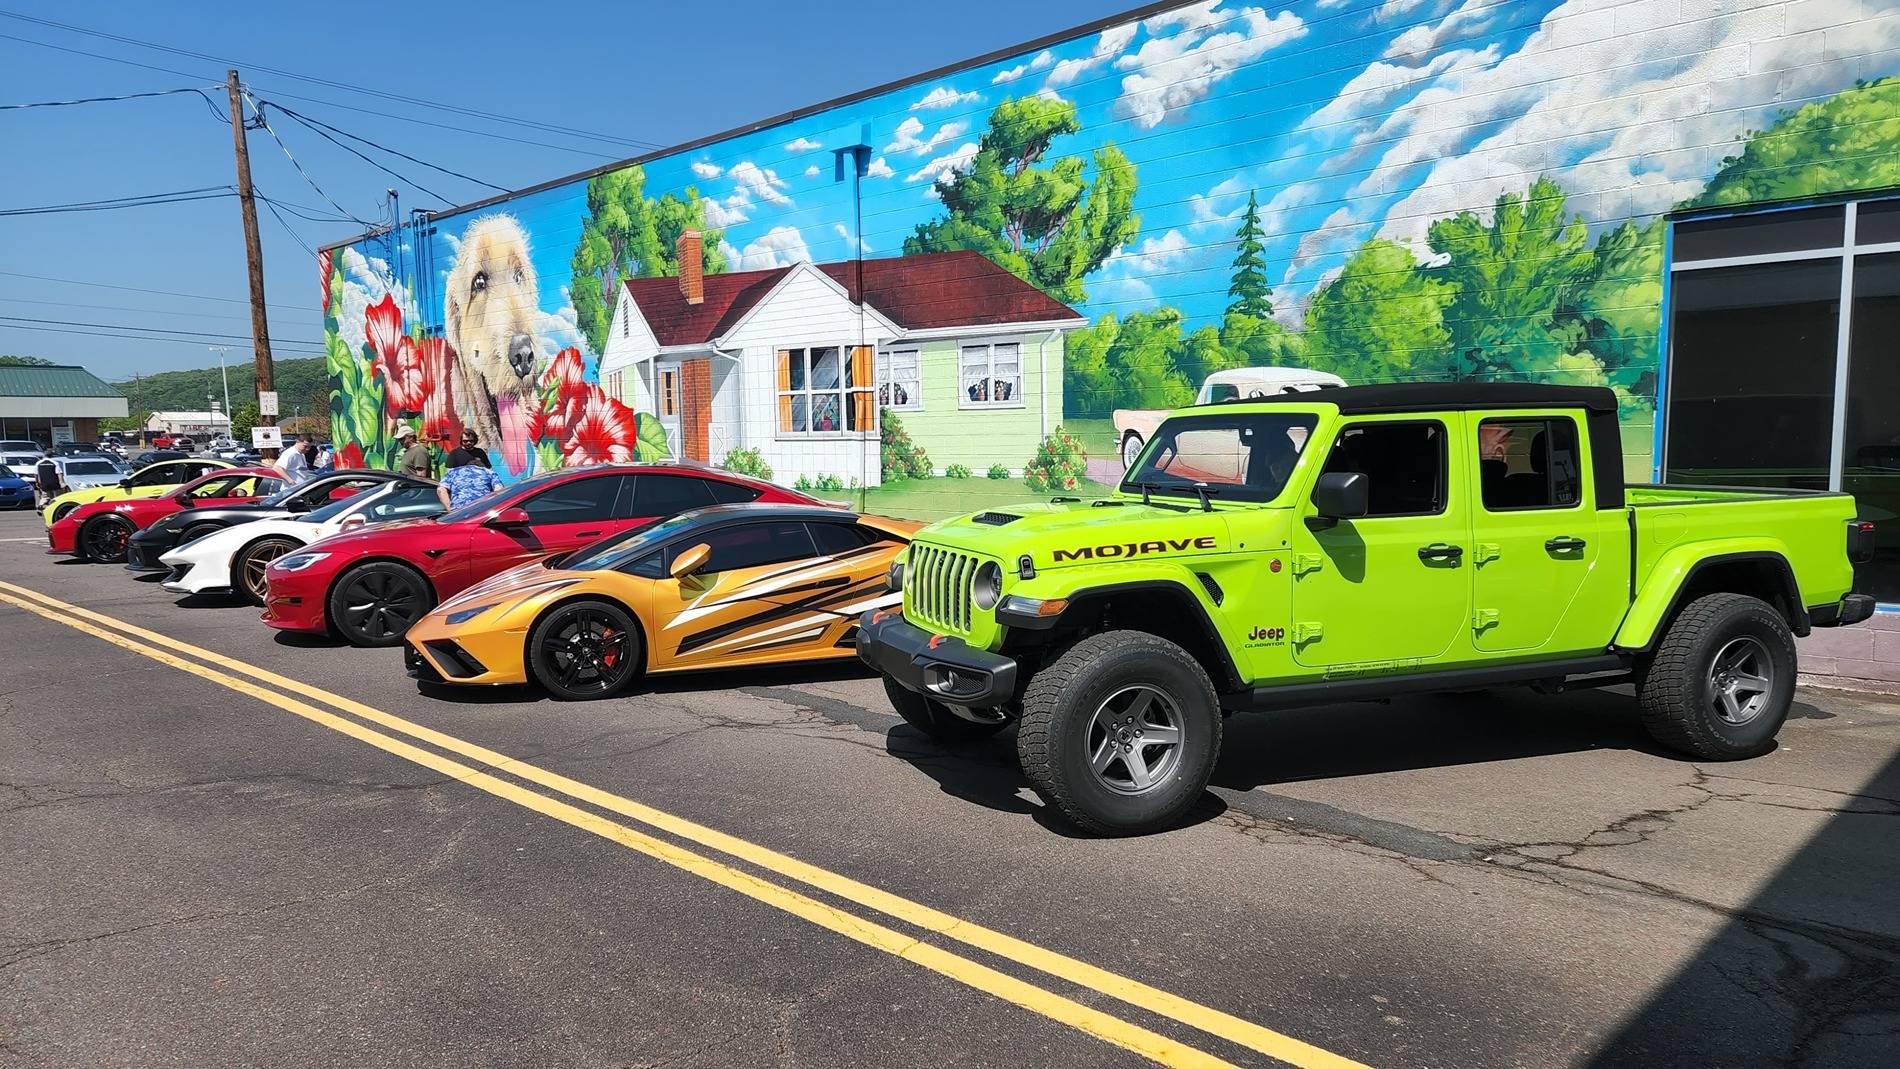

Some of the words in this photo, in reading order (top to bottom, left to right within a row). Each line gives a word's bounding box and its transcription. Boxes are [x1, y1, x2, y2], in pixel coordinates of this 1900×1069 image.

[1053, 536, 1216, 562] MOJAVE
[1248, 625, 1285, 641] Jeep
[1244, 641, 1285, 649] GLADIATOR
